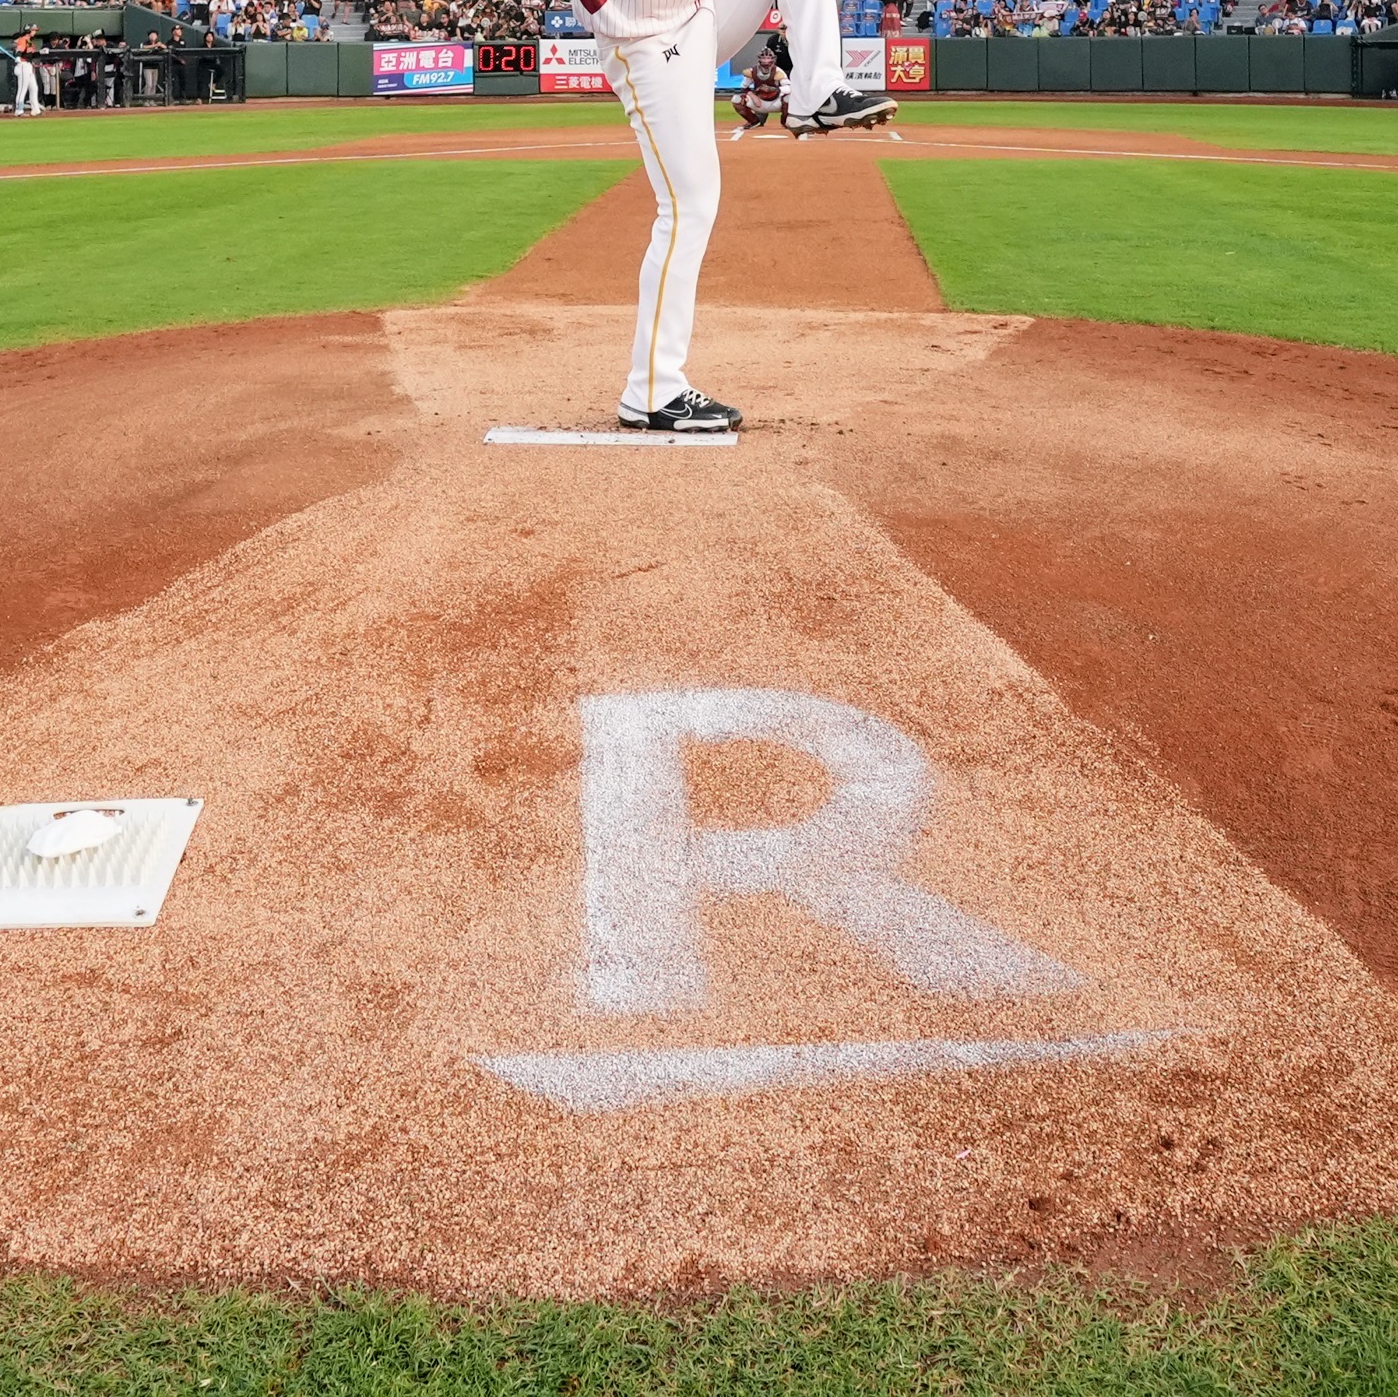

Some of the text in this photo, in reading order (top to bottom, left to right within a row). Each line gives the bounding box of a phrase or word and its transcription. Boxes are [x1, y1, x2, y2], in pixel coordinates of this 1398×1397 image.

[380, 51, 454, 70] 亞洲電台
[479, 46, 535, 71] 0:20
[889, 46, 926, 65] 滿貫
[412, 71, 455, 85] FM92.7
[555, 76, 603, 89] 三菱電機
[889, 66, 926, 84] 大亨
[579, 686, 1083, 1007] R
